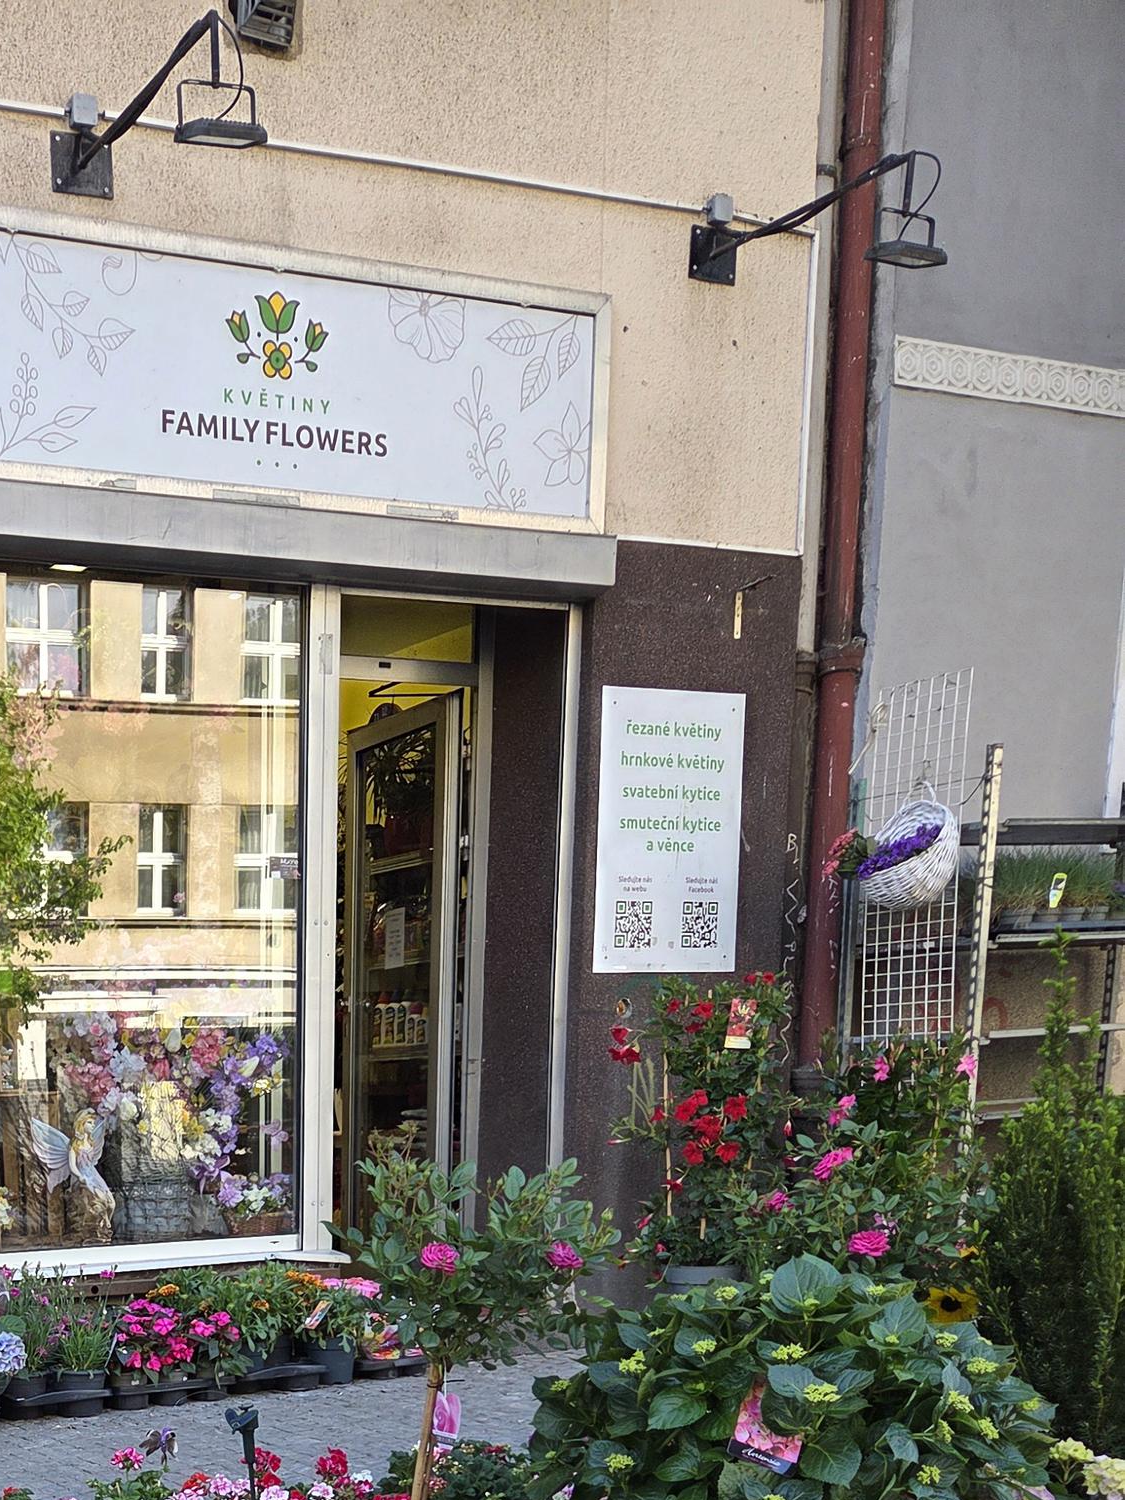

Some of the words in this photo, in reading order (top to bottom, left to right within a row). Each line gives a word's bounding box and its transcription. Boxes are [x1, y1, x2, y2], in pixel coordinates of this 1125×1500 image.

[223, 388, 331, 415] KVĚTINY
[161, 409, 260, 443] FAMILY
[266, 421, 388, 457] FLOWERS
[626, 719, 670, 737] řezané
[674, 721, 722, 742] květiny
[621, 751, 674, 768] hrnkové
[677, 753, 725, 773] květiny
[622, 784, 679, 799] svatební
[682, 785, 721, 803] kytice
[620, 816, 679, 830] smuteční
[682, 816, 722, 834] kytice
[646, 841, 654, 852] a
[657, 837, 695, 852] věnce
